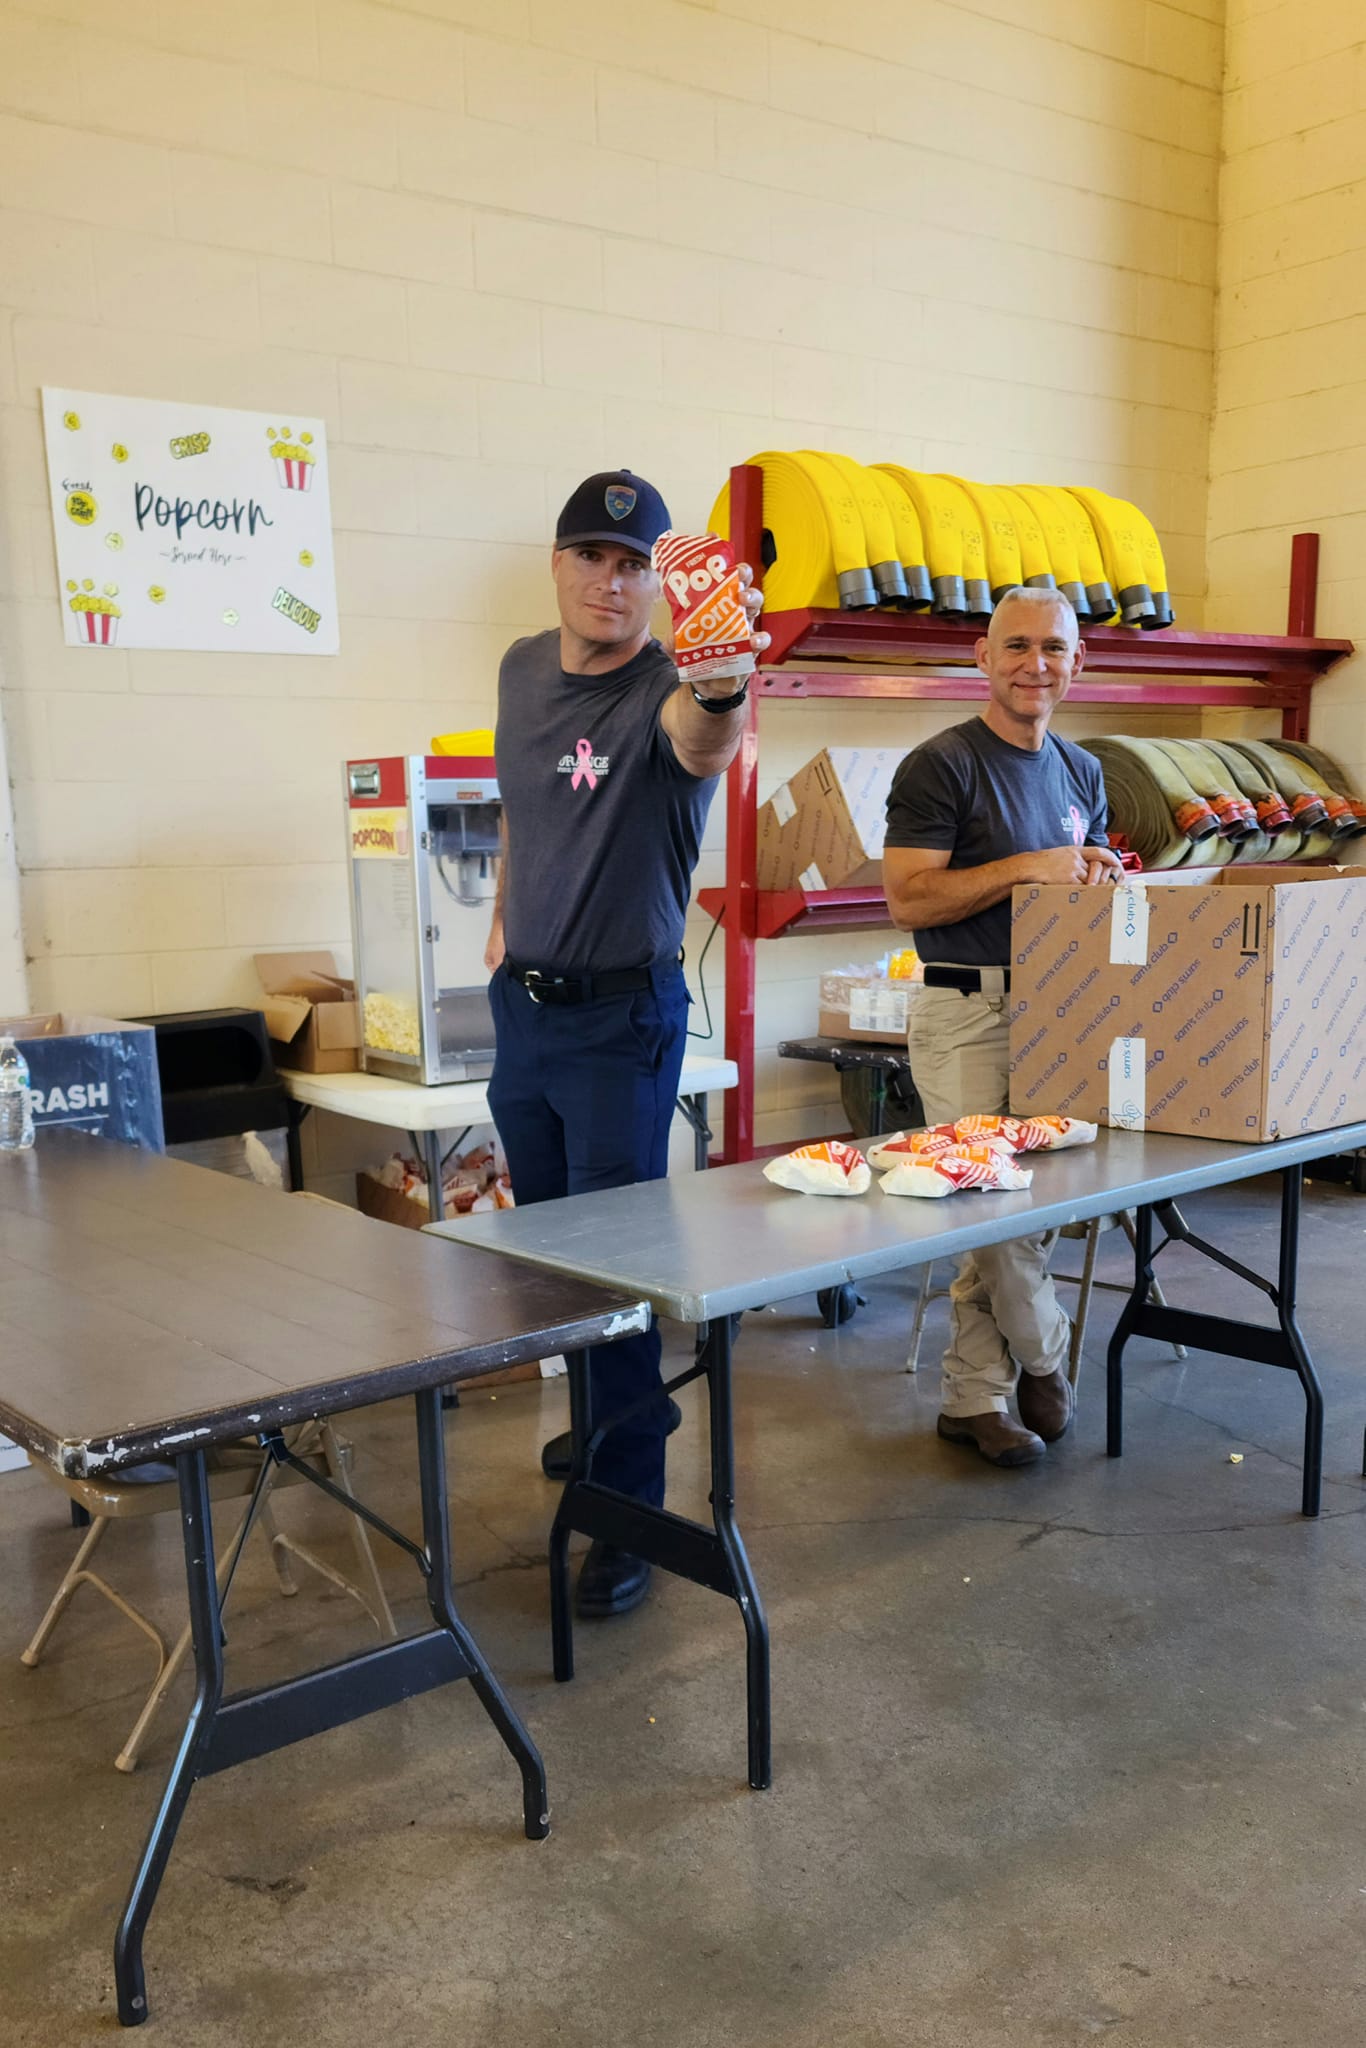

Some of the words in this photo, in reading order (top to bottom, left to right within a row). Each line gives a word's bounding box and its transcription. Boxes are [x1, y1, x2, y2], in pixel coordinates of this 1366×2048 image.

[169, 432, 211, 460] CRISP
[134, 481, 274, 541] Popcorn
[272, 587, 321, 633] DELICIOUS
[558, 755, 609, 769] ORGE
[353, 828, 395, 851] POPCORN
[1127, 896, 1137, 922] club
[1222, 916, 1241, 938] club
[1123, 1048, 1132, 1080] sam's
[29, 1082, 110, 1114] RASH
[1220, 1073, 1245, 1099] sam's
